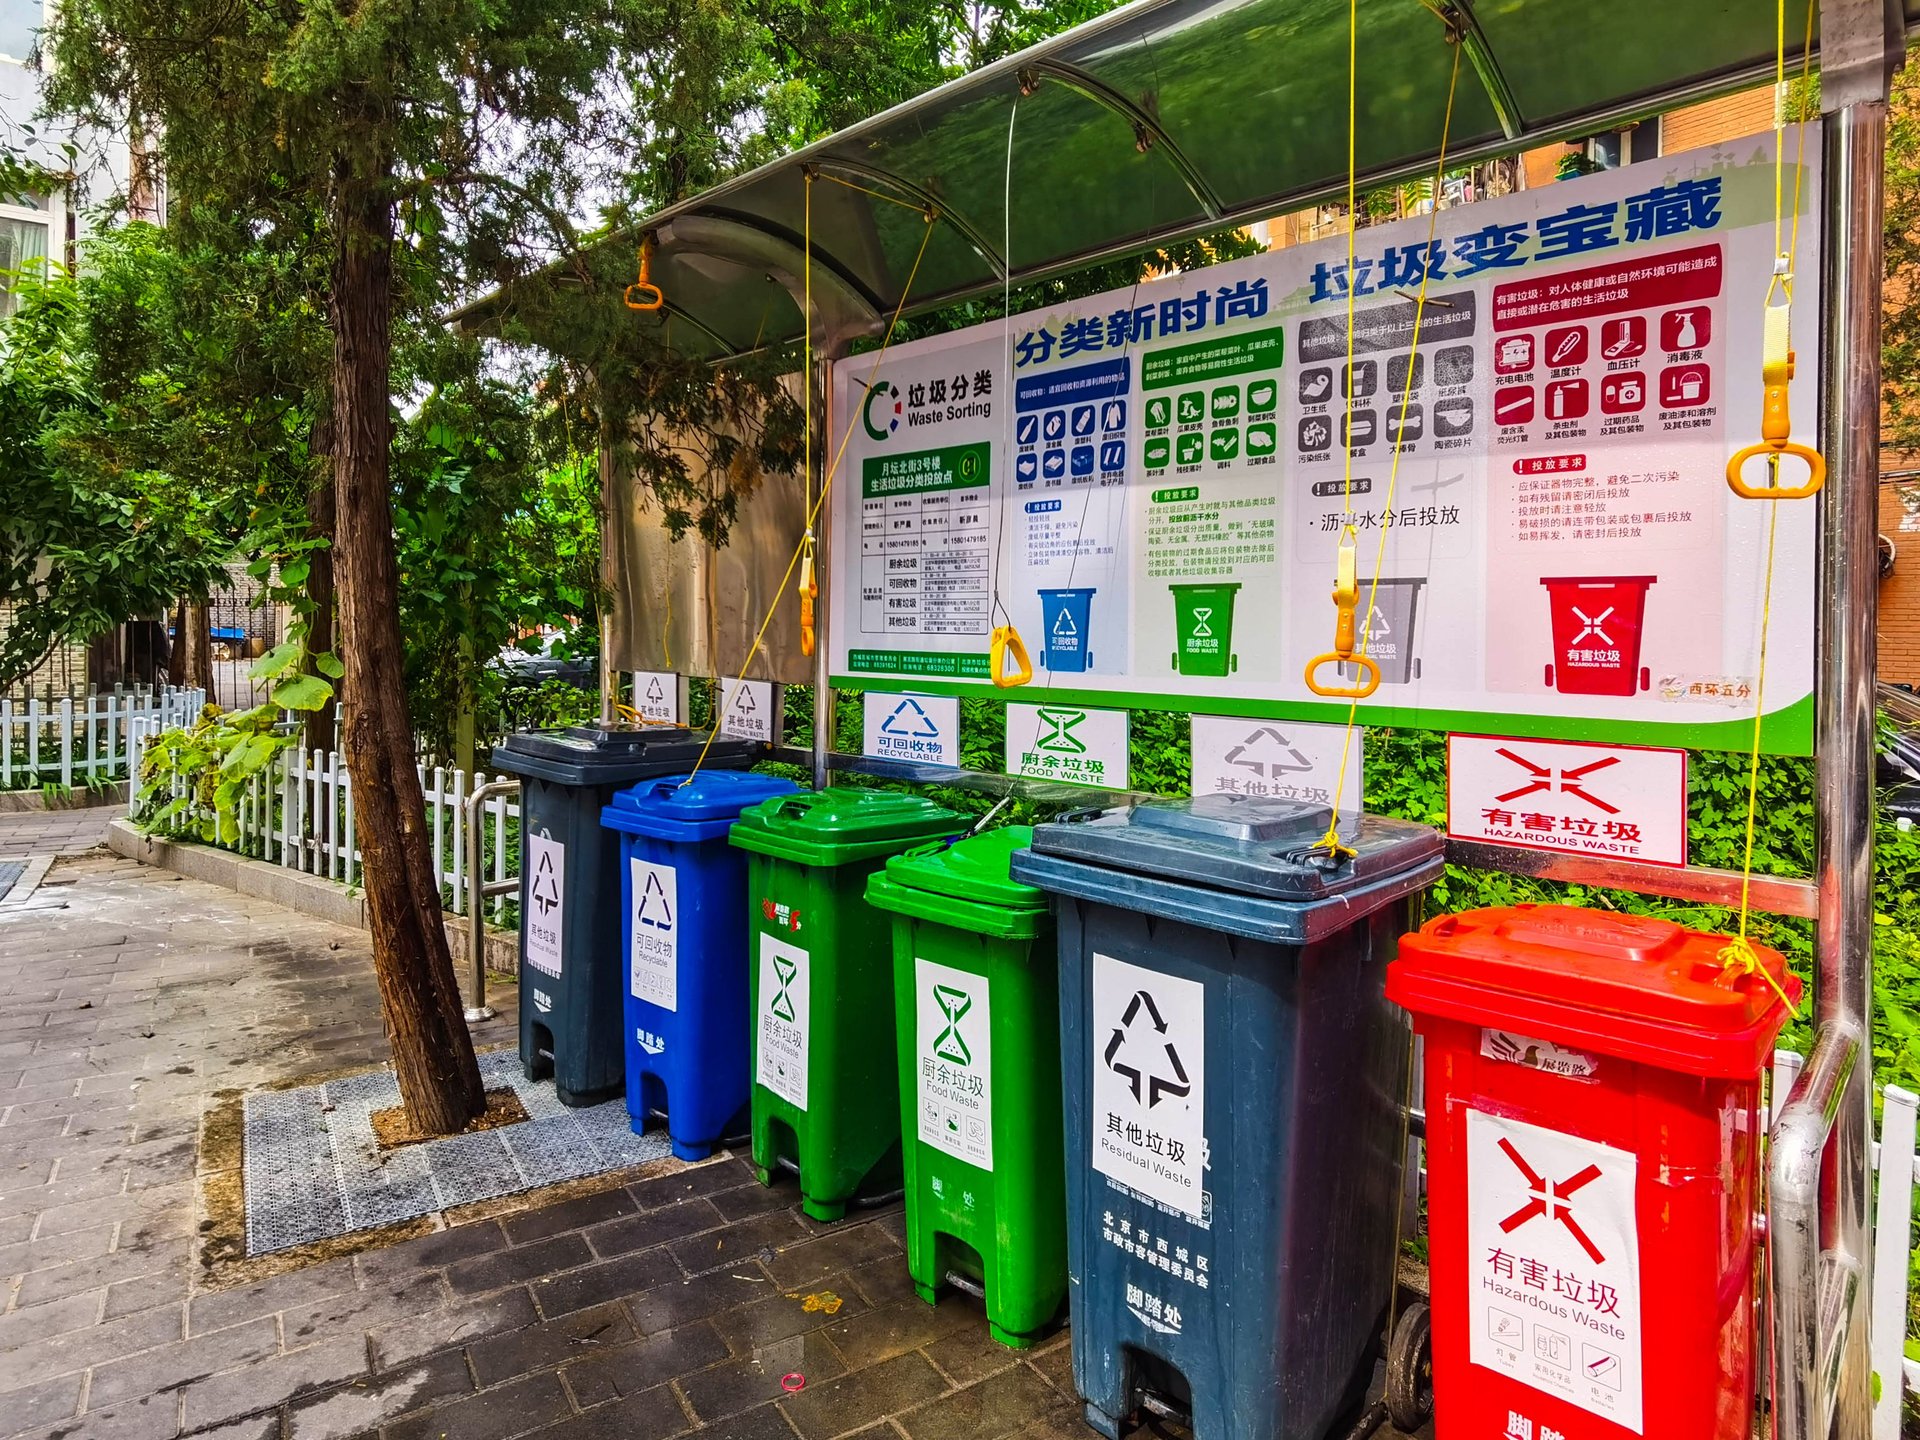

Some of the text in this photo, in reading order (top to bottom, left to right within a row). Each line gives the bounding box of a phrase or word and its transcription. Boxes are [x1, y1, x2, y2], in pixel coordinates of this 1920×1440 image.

[1015, 175, 1723, 366] 分类新时尚 垃圾变宝藏
[1496, 255, 1718, 305] 有害垃圾：对人体健康或自然环境可能造成
[1496, 287, 1630, 320] 直接或潜在危害的生活垃圾
[1667, 350, 1704, 363] 消毒液
[1607, 358, 1641, 371] 血压计
[1495, 372, 1535, 385] 充电电池
[1550, 366, 1582, 379] 温度计
[908, 369, 992, 408] 垃圾分类
[908, 402, 991, 427] Waste Sorting
[1302, 404, 1327, 415] 卫生纸
[1658, 407, 1717, 422] 废油漆和溶剂
[1212, 418, 1239, 428] 鱼骨鱼刺
[1248, 412, 1276, 423] 剩菜剩饭
[1603, 415, 1640, 427] 过期药品
[1663, 418, 1712, 431] 及其包装物
[1177, 422, 1203, 433] 瓜果皮壳
[1501, 425, 1525, 436] 废含汞
[1552, 420, 1579, 430] 杀虫剂
[1600, 424, 1645, 437] 及其包装物
[1497, 434, 1529, 445] 荧光灯管
[1545, 428, 1587, 440] 及其包装物
[1434, 438, 1472, 450] 陶瓷碎片
[1247, 456, 1276, 466] 过期食品
[1298, 452, 1331, 463] 污染纸张
[1532, 458, 1583, 471] 投放要求
[881, 456, 940, 476] 月坛北街3号楼
[1176, 465, 1202, 474] 残枝落叶
[1217, 461, 1231, 469] 调料
[1146, 469, 1165, 477] 茶叶渣
[871, 470, 953, 492] 生活垃圾分类投放点
[1100, 478, 1124, 487] 电子产品
[1517, 471, 1680, 492] 应保证器物完整，避免二次污染
[1164, 489, 1196, 500] 投放要求
[1518, 488, 1630, 504] 如有残留请密闭后投放
[1034, 501, 1060, 512] 投放要求
[1148, 497, 1275, 515] 厨余垃圾应从产生时就与其他品类垃圾
[1518, 503, 1607, 516] 投放时请注意轻放
[1518, 511, 1692, 529] 易破损的请连带包装或包裹后投放
[1518, 527, 1642, 542] 如易挥发，请密封后投放
[1148, 544, 1275, 558] 有包装物的过期食品应将包装物去除后
[889, 558, 917, 569] 厨余垃圾
[889, 578, 917, 588] 可回收物
[889, 598, 916, 608] 有害垃圾
[889, 617, 916, 626] 其他垃圾
[1186, 638, 1219, 648] 厨余垃圾
[1355, 643, 1396, 654] 其他垃圾
[1567, 649, 1621, 663] 有害垃圾
[1689, 682, 1752, 699] 西环五分
[641, 706, 670, 718] 其他垃圾
[728, 715, 764, 730] 其他垃圾
[749, 731, 764, 739] WASTE
[877, 736, 943, 755] 可回收物
[877, 748, 944, 762] RECYCLABLE
[1021, 752, 1105, 775] 厨余垃圾
[1021, 765, 1105, 784] FOOD WASTE
[1214, 776, 1331, 805] 其他垃圾
[1481, 808, 1643, 843] 有害垃圾
[1484, 827, 1639, 855] HAZARDOUS WASTE
[531, 923, 556, 945] 其他垃圾
[636, 932, 673, 958] 可回收物
[638, 950, 668, 968] Recyclable
[763, 1014, 802, 1049] 厨余垃圾
[636, 1028, 665, 1050] 脚踏处
[765, 1034, 799, 1059] Food Waste
[922, 1057, 984, 1098] 厨余垃圾
[926, 1080, 979, 1110] Food Waste
[1106, 1111, 1186, 1167] 其他垃圾
[1101, 1137, 1151, 1170] Residual
[1153, 1165, 1192, 1188] Waste
[1103, 1210, 1209, 1272] 北京市西城区
[1102, 1228, 1209, 1289] 市政市容管理委员会
[1487, 1247, 1621, 1319] 有害垃圾
[1126, 1283, 1183, 1329] 脚踏处
[1483, 1277, 1626, 1341] Hazardous Waste
[1590, 1386, 1615, 1403] 电池
